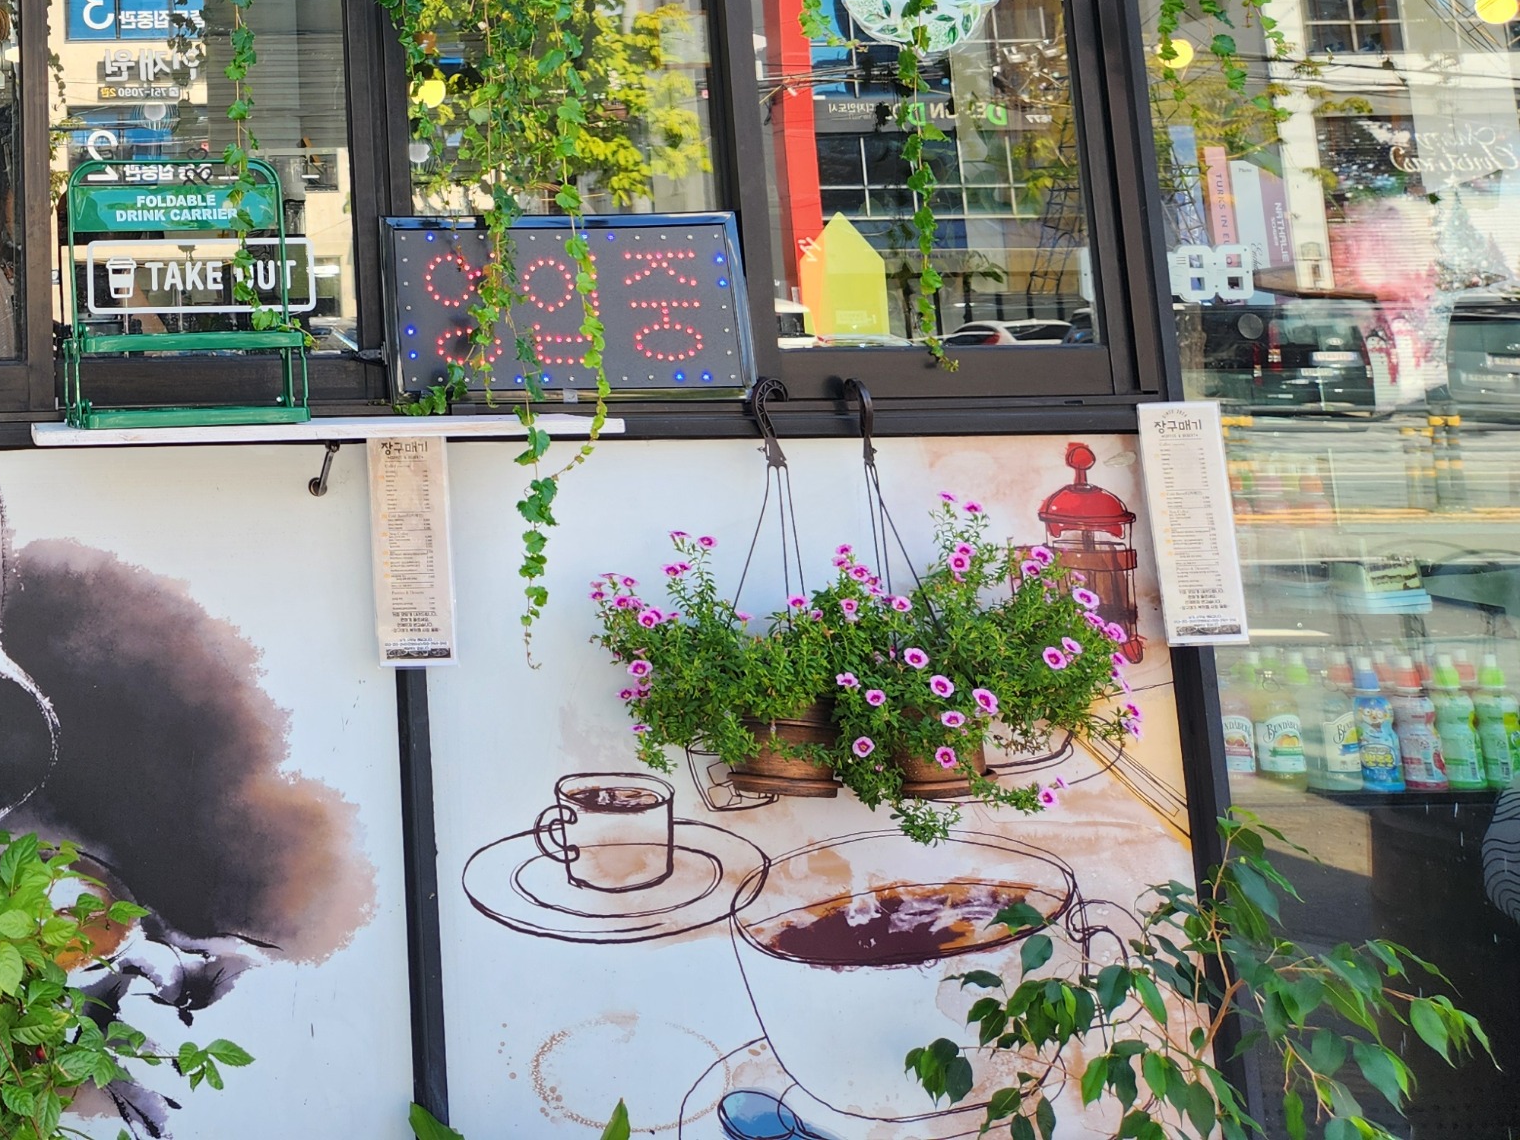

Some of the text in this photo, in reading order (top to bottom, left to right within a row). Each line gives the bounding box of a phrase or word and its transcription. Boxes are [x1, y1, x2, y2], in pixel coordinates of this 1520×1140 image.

[1215, 173, 1226, 210] TURKS
[136, 194, 216, 208] FOLDABLE
[115, 208, 238, 222] DRINK CARRIER
[1220, 215, 1228, 228] IN
[144, 260, 224, 292] TAKE
[1153, 419, 1203, 435] 장구매기
[380, 440, 428, 456] 장구매기
